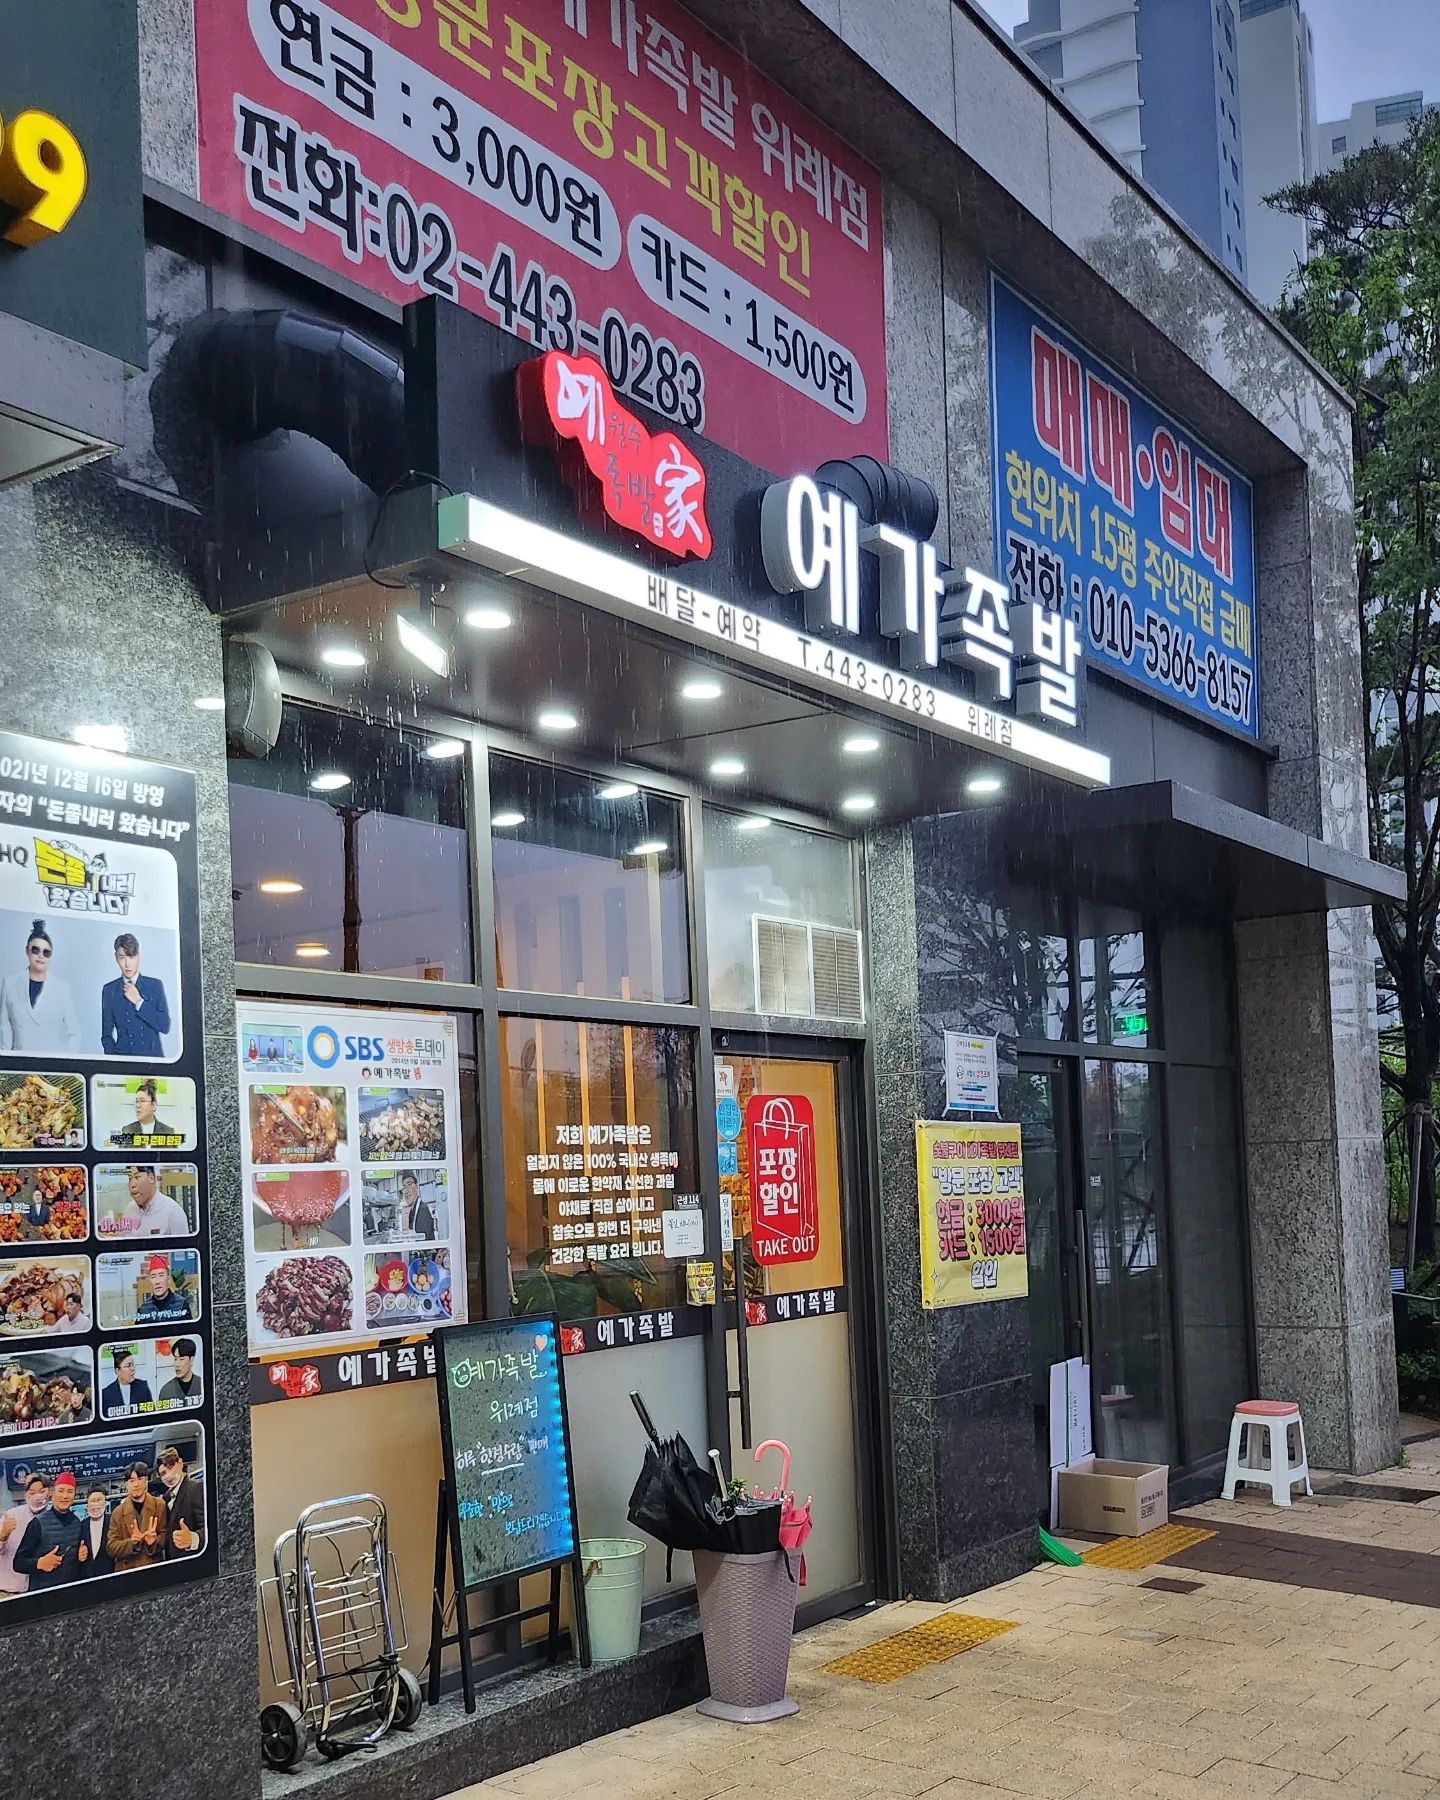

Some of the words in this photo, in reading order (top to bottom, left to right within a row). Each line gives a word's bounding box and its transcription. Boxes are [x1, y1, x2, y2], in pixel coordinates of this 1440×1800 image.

[0, 110, 88, 233] 9
[432, 96, 603, 257] 3,000원
[641, 224, 711, 312] 카드
[745, 299, 855, 416] 1,500원
[1005, 450, 1081, 556] 현위치
[1089, 505, 1137, 589] 15평
[1144, 539, 1214, 633] 주인직접
[1219, 592, 1252, 658] 급매
[785, 474, 1082, 727] 예가족발
[646, 574, 762, 652] 배달-예약
[797, 637, 937, 717] T.443-0283
[966, 704, 1013, 747] 위례점
[1089, 581, 1252, 725] 010-5366-8157
[54, 767, 89, 793] 12월
[94, 775, 128, 801] 16일
[132, 781, 165, 808] 방영
[344, 1036, 385, 1061] SBS
[373, 1066, 411, 1080] 예가족발
[556, 1125, 583, 1145] 저희
[587, 1124, 652, 1145] 예가족발은
[526, 1154, 560, 1172] 얼리지
[562, 1153, 584, 1170] 않은
[585, 1153, 617, 1169] 100%
[618, 1152, 648, 1168] 국내산
[759, 1147, 798, 1181] 포장
[532, 1177, 555, 1195] 몸에
[557, 1176, 590, 1193] 이로운
[591, 1175, 622, 1192] 한약재
[624, 1174, 654, 1190] 신선한
[655, 1173, 675, 1189] 과일
[967, 1166, 994, 1194] 포장
[558, 1200, 591, 1217] 야채로
[593, 1198, 613, 1214] 직접
[759, 1181, 799, 1217] 할인
[936, 1199, 964, 1231] 현금
[975, 1196, 1025, 1228] 3000원
[597, 1220, 618, 1237] 한번
[620, 1220, 631, 1236] 더
[631, 1217, 662, 1235] 구워낸
[938, 1229, 970, 1261] 카드
[978, 1223, 1025, 1256] 1500원
[551, 1246, 584, 1265] 건강한
[586, 1243, 608, 1261] 족발
[609, 1242, 630, 1259] 요리
[756, 1237, 789, 1259] TAKE
[792, 1234, 816, 1254] OUT
[971, 1258, 999, 1289] 할인
[776, 1289, 836, 1319] 예가족발
[597, 1311, 674, 1347] 예가족발
